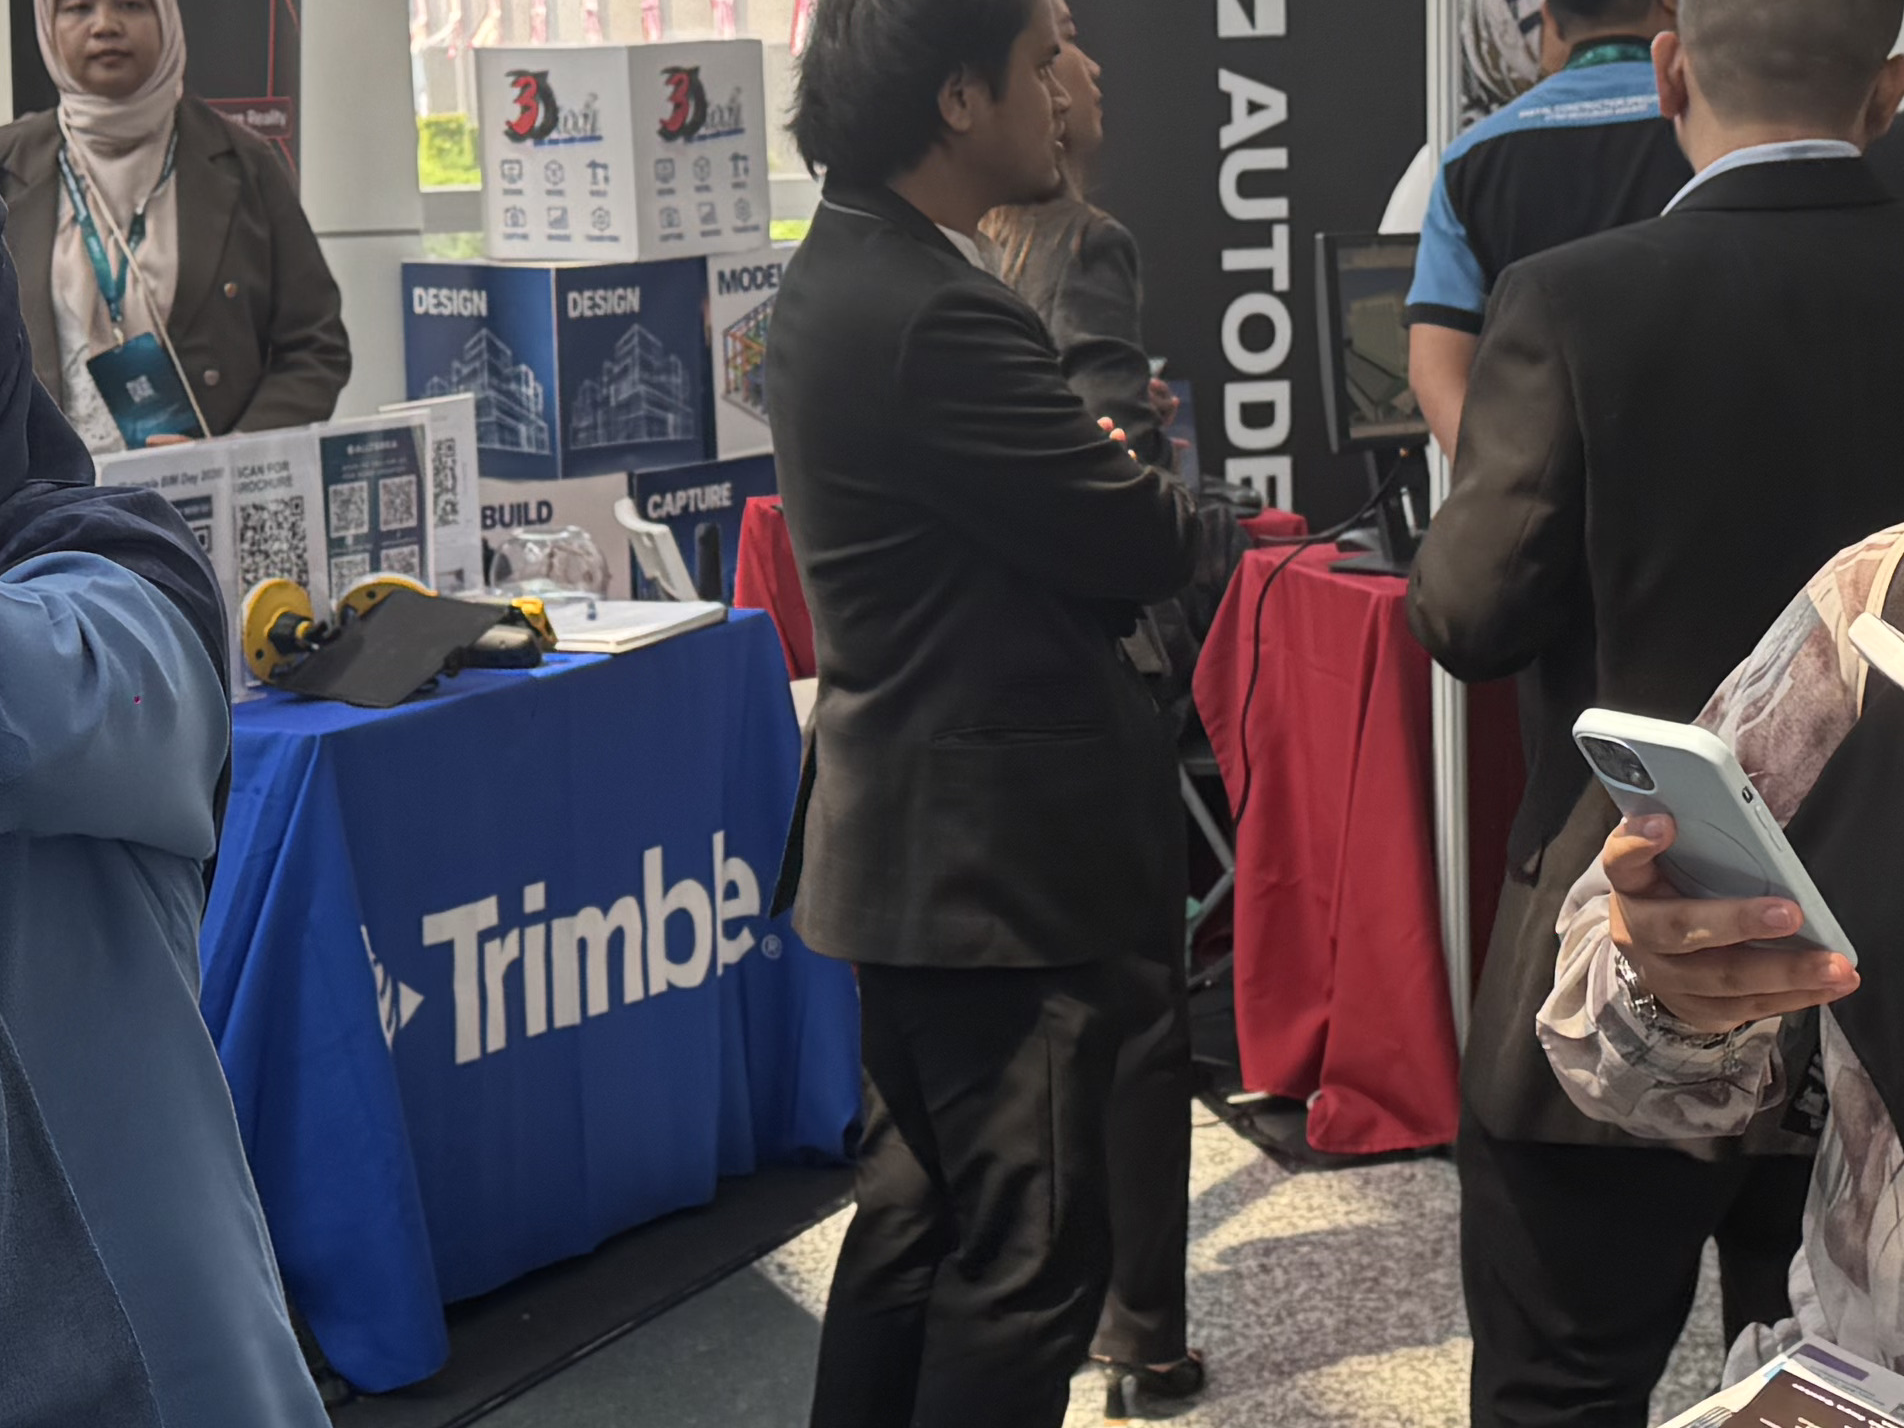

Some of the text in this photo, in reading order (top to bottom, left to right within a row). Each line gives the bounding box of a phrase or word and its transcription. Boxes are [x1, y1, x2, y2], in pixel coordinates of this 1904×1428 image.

[412, 286, 488, 318] DESIGN
[567, 286, 640, 319] DESIGN
[480, 499, 553, 530] BUILD
[647, 481, 733, 520] CAPTURE
